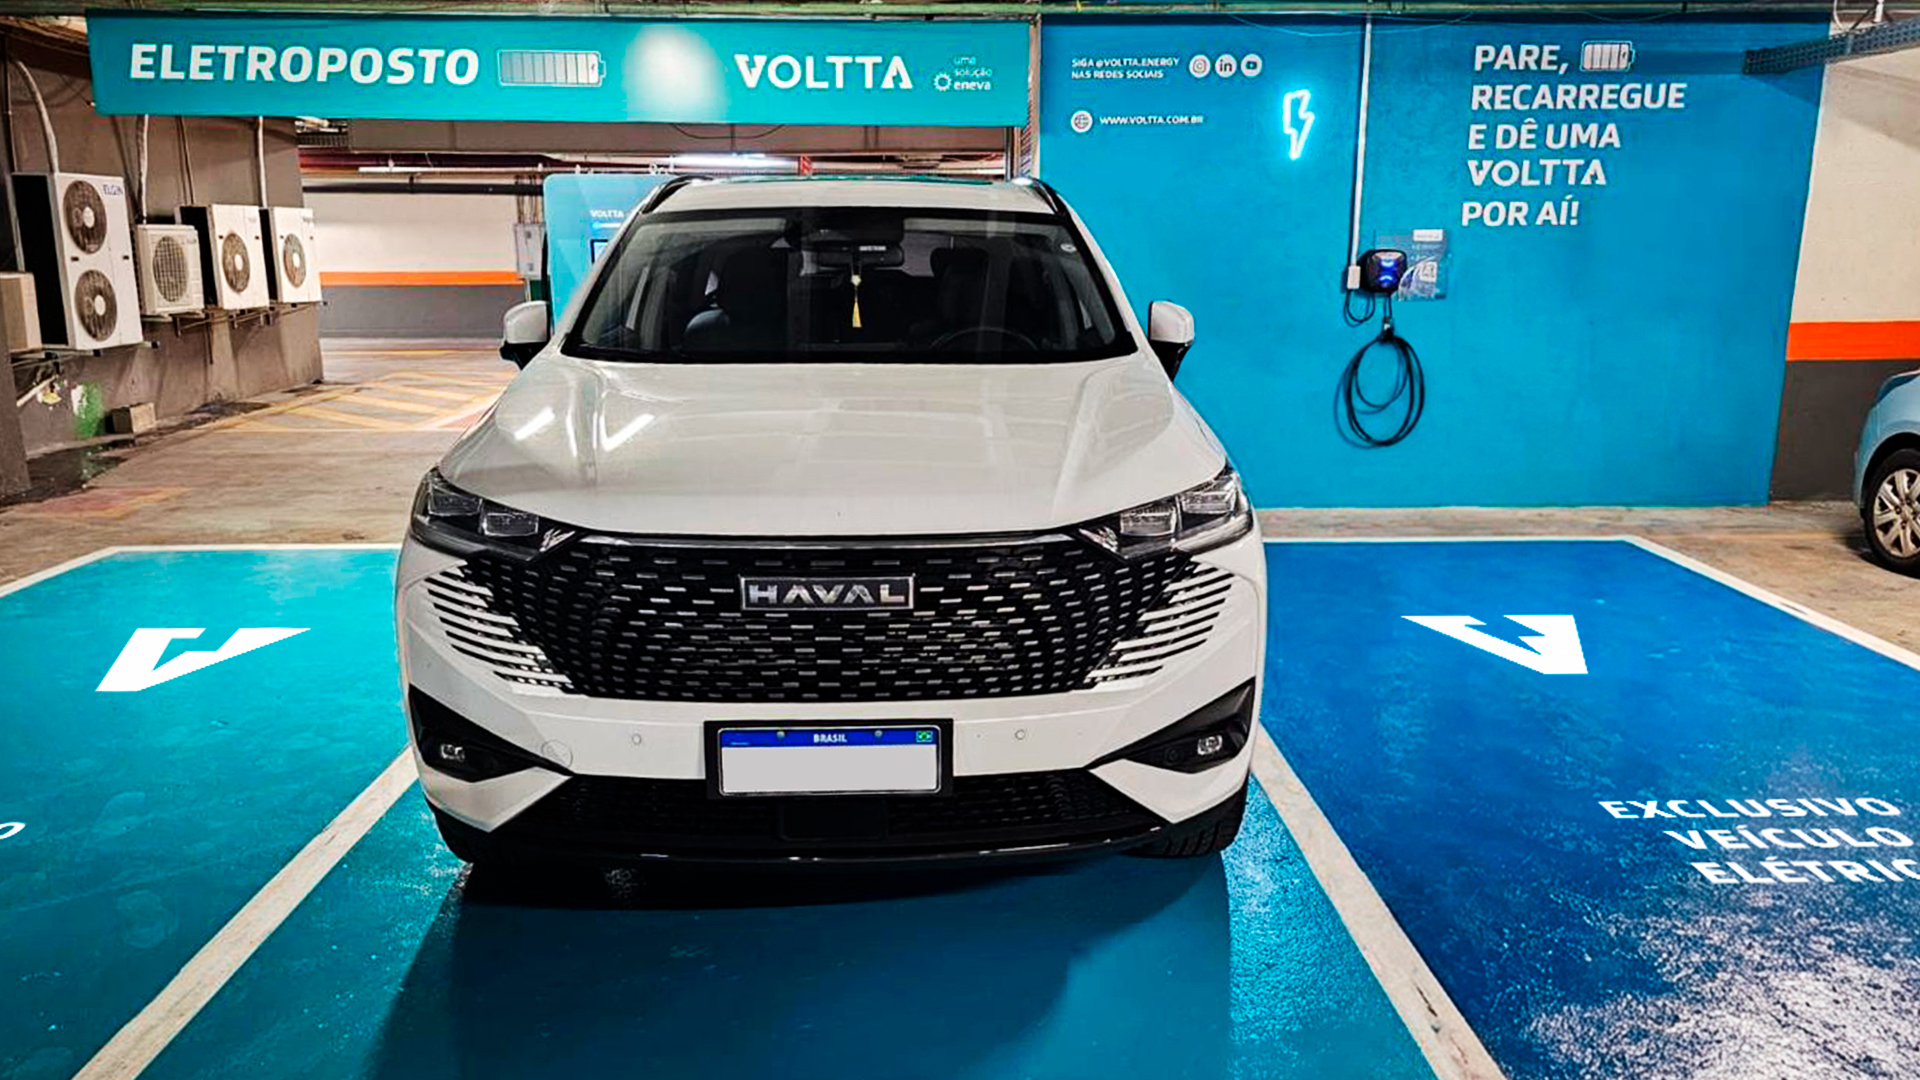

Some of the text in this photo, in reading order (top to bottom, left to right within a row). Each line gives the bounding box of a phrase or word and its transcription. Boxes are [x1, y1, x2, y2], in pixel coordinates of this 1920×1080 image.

[130, 43, 480, 85] ELETROPOSTO
[954, 56, 976, 65] uma
[1072, 58, 1094, 68] SIGA
[1474, 44, 1569, 75] PARE,
[733, 53, 913, 90] VOLTTA
[1072, 70, 1164, 79] NAS REDES SOCIAIS
[953, 81, 991, 90] eneva
[1471, 82, 1688, 111] RECARREGUE
[1099, 115, 1203, 125] WWW.VOLTTA.COM.BR
[1468, 117, 1621, 150] E DÊ UMA
[1467, 158, 1606, 187] VOLTTA
[589, 209, 624, 218] VOLTTA
[1461, 194, 1580, 227] POR AÍ!
[749, 583, 905, 604] HAVAL
[813, 733, 848, 743] BRASIL
[1598, 797, 1902, 819] EXCLUSIVO
[1663, 824, 1914, 850] VEÍCULO
